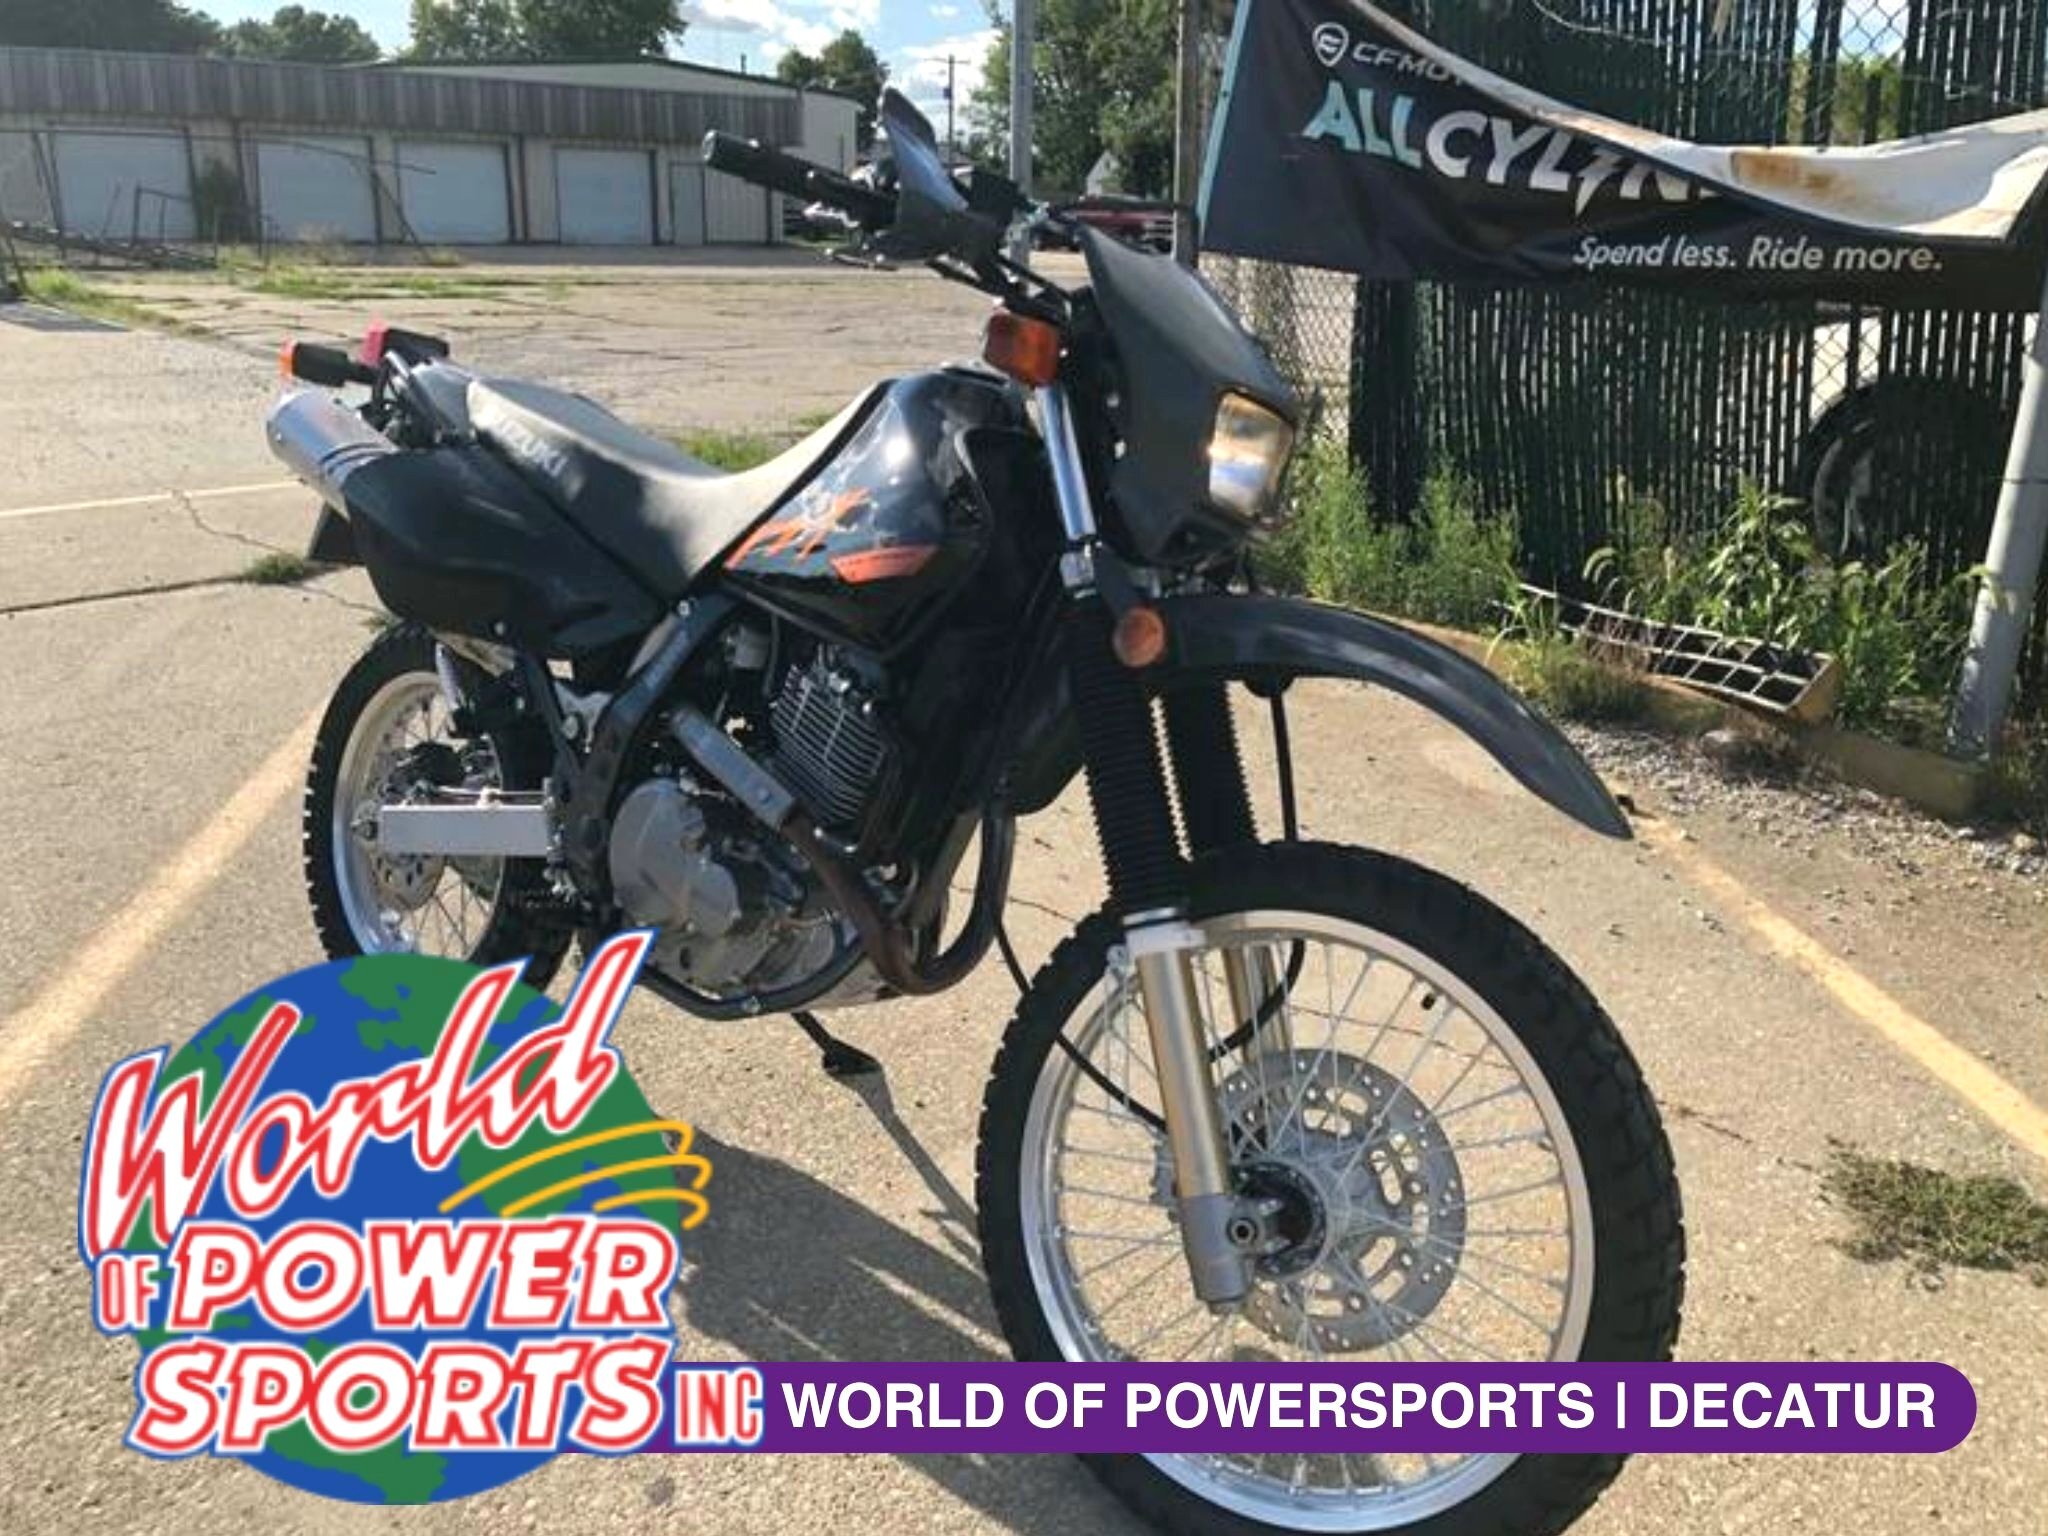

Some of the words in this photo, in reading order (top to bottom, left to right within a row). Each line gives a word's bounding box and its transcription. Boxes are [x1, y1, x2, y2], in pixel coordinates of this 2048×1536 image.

[1353, 41, 1463, 86] CFMO
[1572, 235, 1671, 270] Spend
[1672, 235, 1737, 267] less.
[1747, 235, 1823, 270] Ride
[1833, 246, 1943, 270] more.
